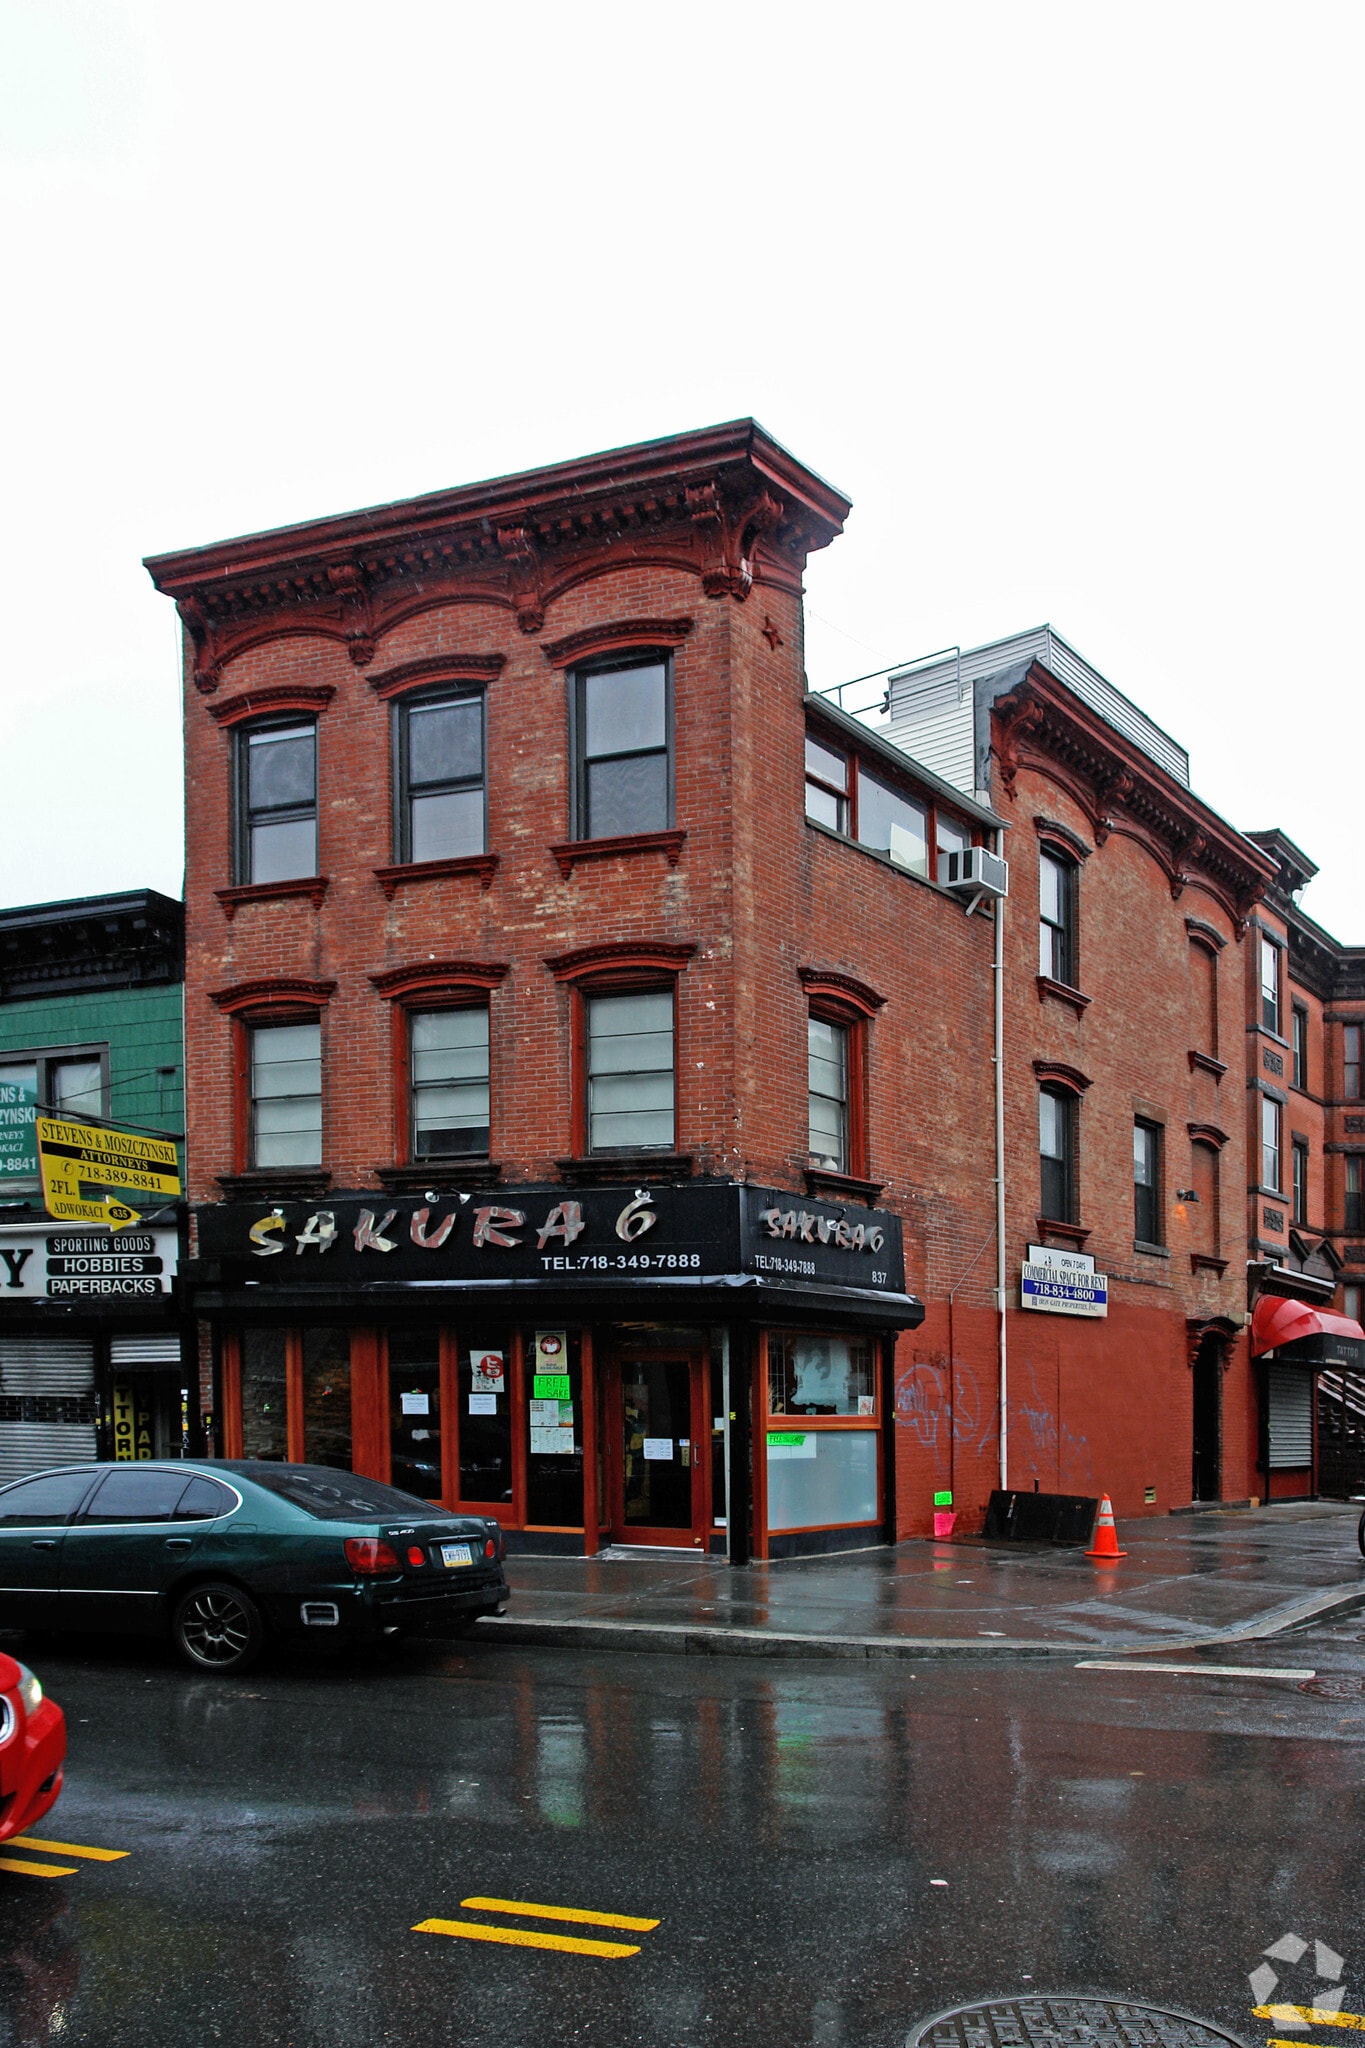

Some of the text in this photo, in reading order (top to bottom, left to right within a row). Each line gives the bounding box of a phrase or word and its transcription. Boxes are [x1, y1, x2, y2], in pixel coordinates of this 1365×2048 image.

[0, 1087, 26, 1103] NS &
[41, 1122, 175, 1162] STEVENS & MOSZCZYNSKI
[80, 1150, 149, 1171] ATTORNEYS
[78, 1165, 162, 1190] 718-389-8841
[50, 1180, 76, 1196] 2FL.
[54, 1202, 128, 1219] ADWOKACI 835
[250, 1198, 656, 1256] SAKURA 6
[764, 1208, 885, 1253] SAKURA 6
[54, 1236, 150, 1252] SPORTING GOODS
[0, 1249, 33, 1287] Y
[64, 1258, 143, 1273] HOBBIES
[541, 1254, 701, 1270] TEL:718-349-7888
[1061, 1258, 1072, 1268] OPEN
[872, 1271, 887, 1284] 837
[1024, 1264, 1106, 1290] COMMERCIAL SPACE FOR RENT
[51, 1279, 155, 1294] PAPERBACKS
[1034, 1282, 1095, 1301] 718-834-4800
[1337, 1345, 1359, 1358] TATTOO
[538, 1377, 566, 1388] FREE
[547, 1388, 568, 1398] SAKE
